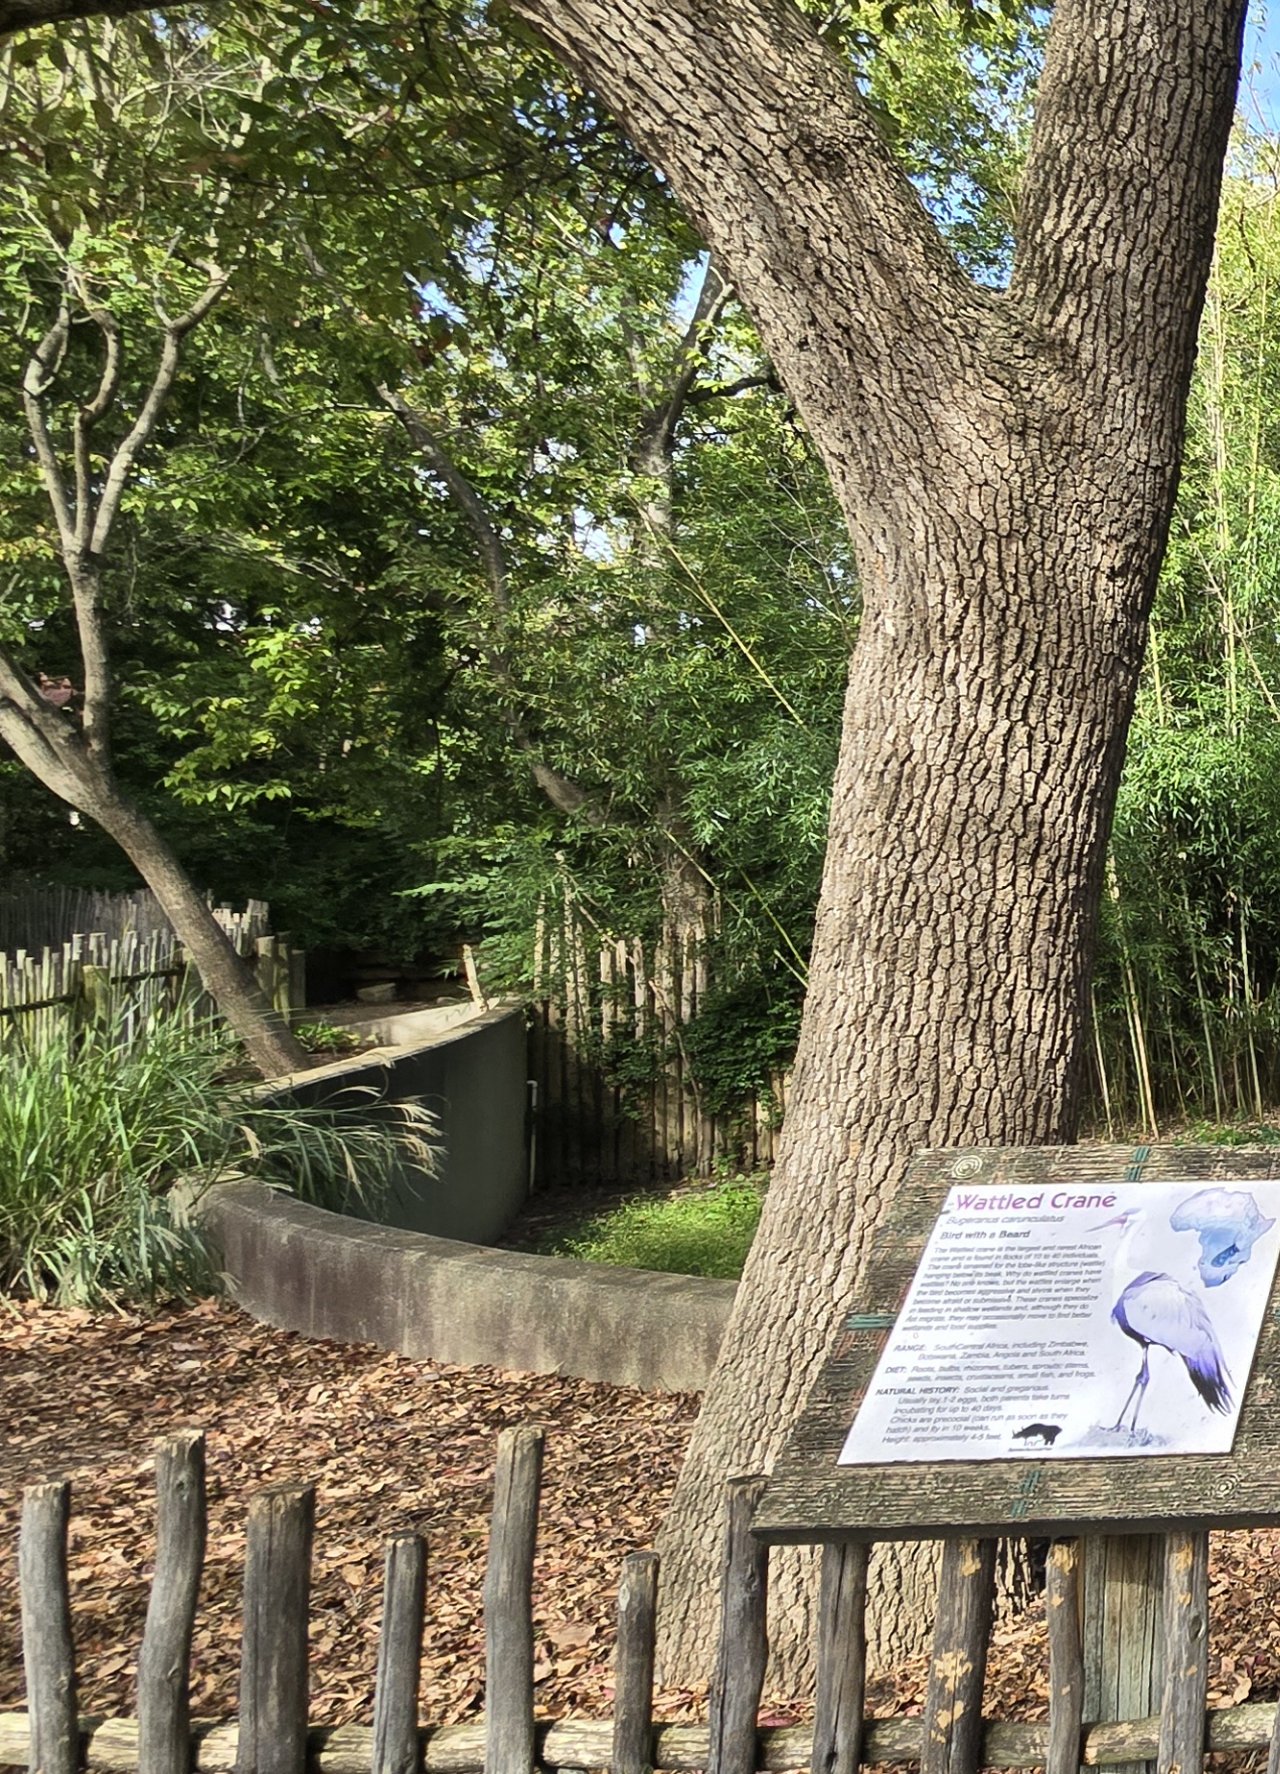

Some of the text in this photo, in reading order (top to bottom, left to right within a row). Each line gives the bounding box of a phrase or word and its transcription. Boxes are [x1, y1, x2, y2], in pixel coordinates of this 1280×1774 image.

[956, 1192, 1117, 1210] Wattled Crane
[941, 1231, 962, 1240] Bird
[966, 1231, 986, 1239] with
[998, 1230, 1030, 1239] Beard
[875, 1387, 917, 1396] NATURAL
[919, 1386, 960, 1395] HISTORY:
[964, 1386, 989, 1394] Social
[990, 1385, 1006, 1393] and
[898, 1396, 927, 1405] Usually
[981, 1395, 999, 1403] both
[1000, 1395, 1030, 1403] parents
[894, 1407, 935, 1415] incubating
[936, 1405, 947, 1413] for
[949, 1406, 960, 1414] up
[971, 1405, 982, 1413] 40
[890, 1416, 918, 1424] Chicks
[972, 1415, 990, 1424] (can
[1051, 1412, 1069, 1421] they
[952, 1424, 962, 1432] 10
